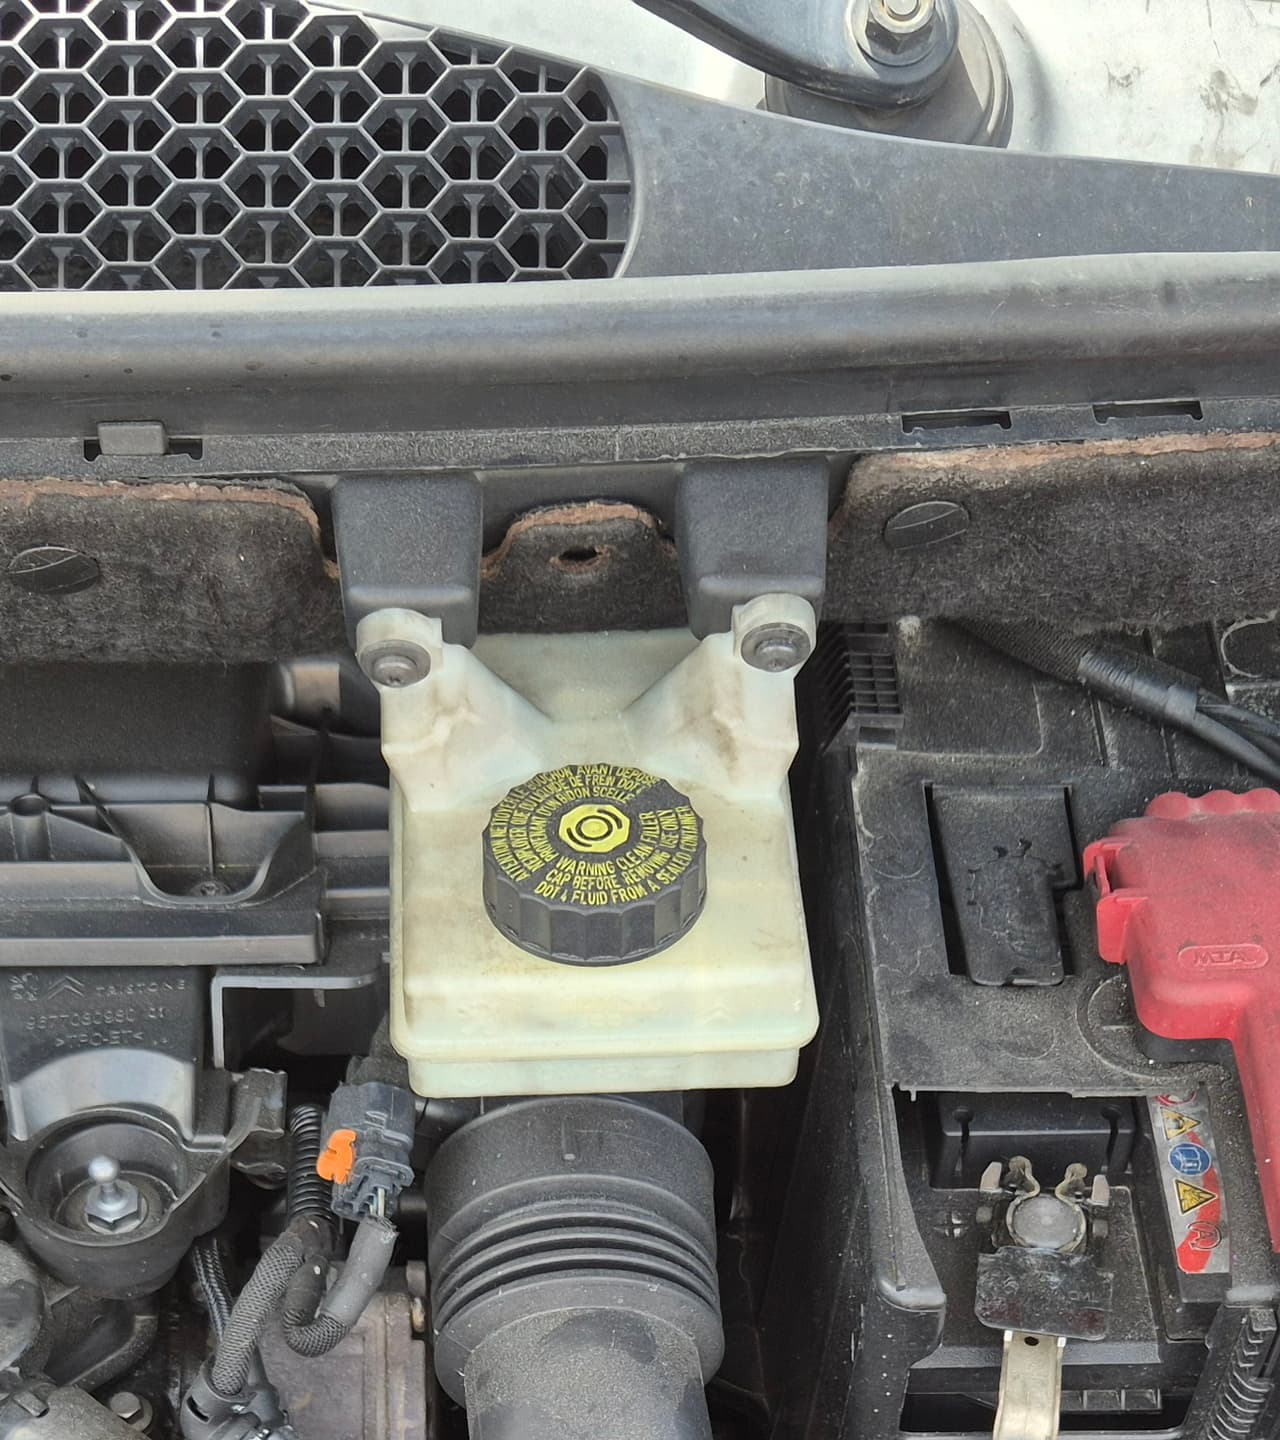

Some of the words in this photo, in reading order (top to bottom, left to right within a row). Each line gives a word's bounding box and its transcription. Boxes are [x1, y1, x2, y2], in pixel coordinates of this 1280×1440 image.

[569, 775, 584, 787] DE
[585, 774, 615, 785] FREIN
[617, 778, 640, 791] DOT
[554, 786, 590, 805] BIDON
[490, 839, 530, 881] ATTENTION
[576, 765, 612, 776] AVANT
[656, 809, 679, 830] ONLY
[555, 856, 616, 876] WARNING
[616, 843, 654, 870] CLEAN
[639, 811, 660, 844] FILLER
[659, 832, 679, 849] USE
[534, 881, 561, 899] DOT
[570, 889, 608, 905] FLUID
[610, 884, 648, 904] FROM
[646, 879, 661, 892] A
[655, 851, 693, 884] SEALED
[675, 805, 699, 852] CONTAINER
[621, 849, 671, 886] REMOVING
[545, 869, 571, 887] CAP
[572, 874, 621, 890] BEFORE
